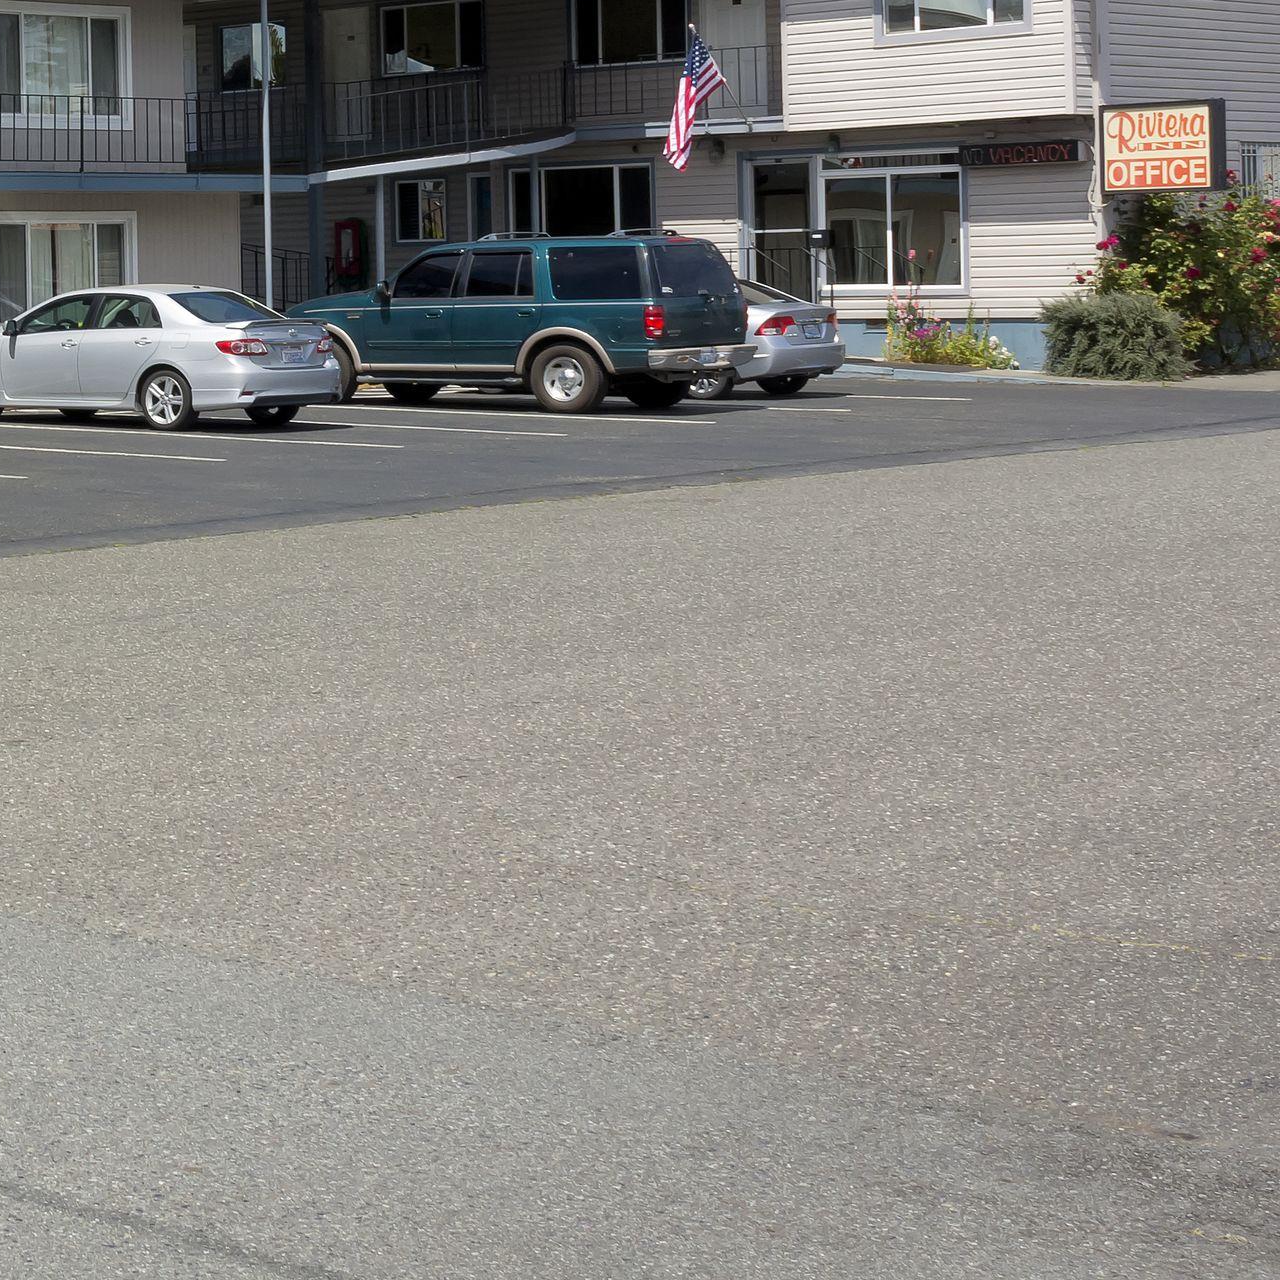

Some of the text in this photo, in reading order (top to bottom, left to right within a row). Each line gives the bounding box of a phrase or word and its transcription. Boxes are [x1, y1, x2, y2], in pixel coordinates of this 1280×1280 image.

[1107, 111, 1206, 153] Riviera
[989, 144, 1073, 164] VACANCY
[1137, 140, 1206, 151] INN
[1108, 159, 1206, 187] OFFICE
